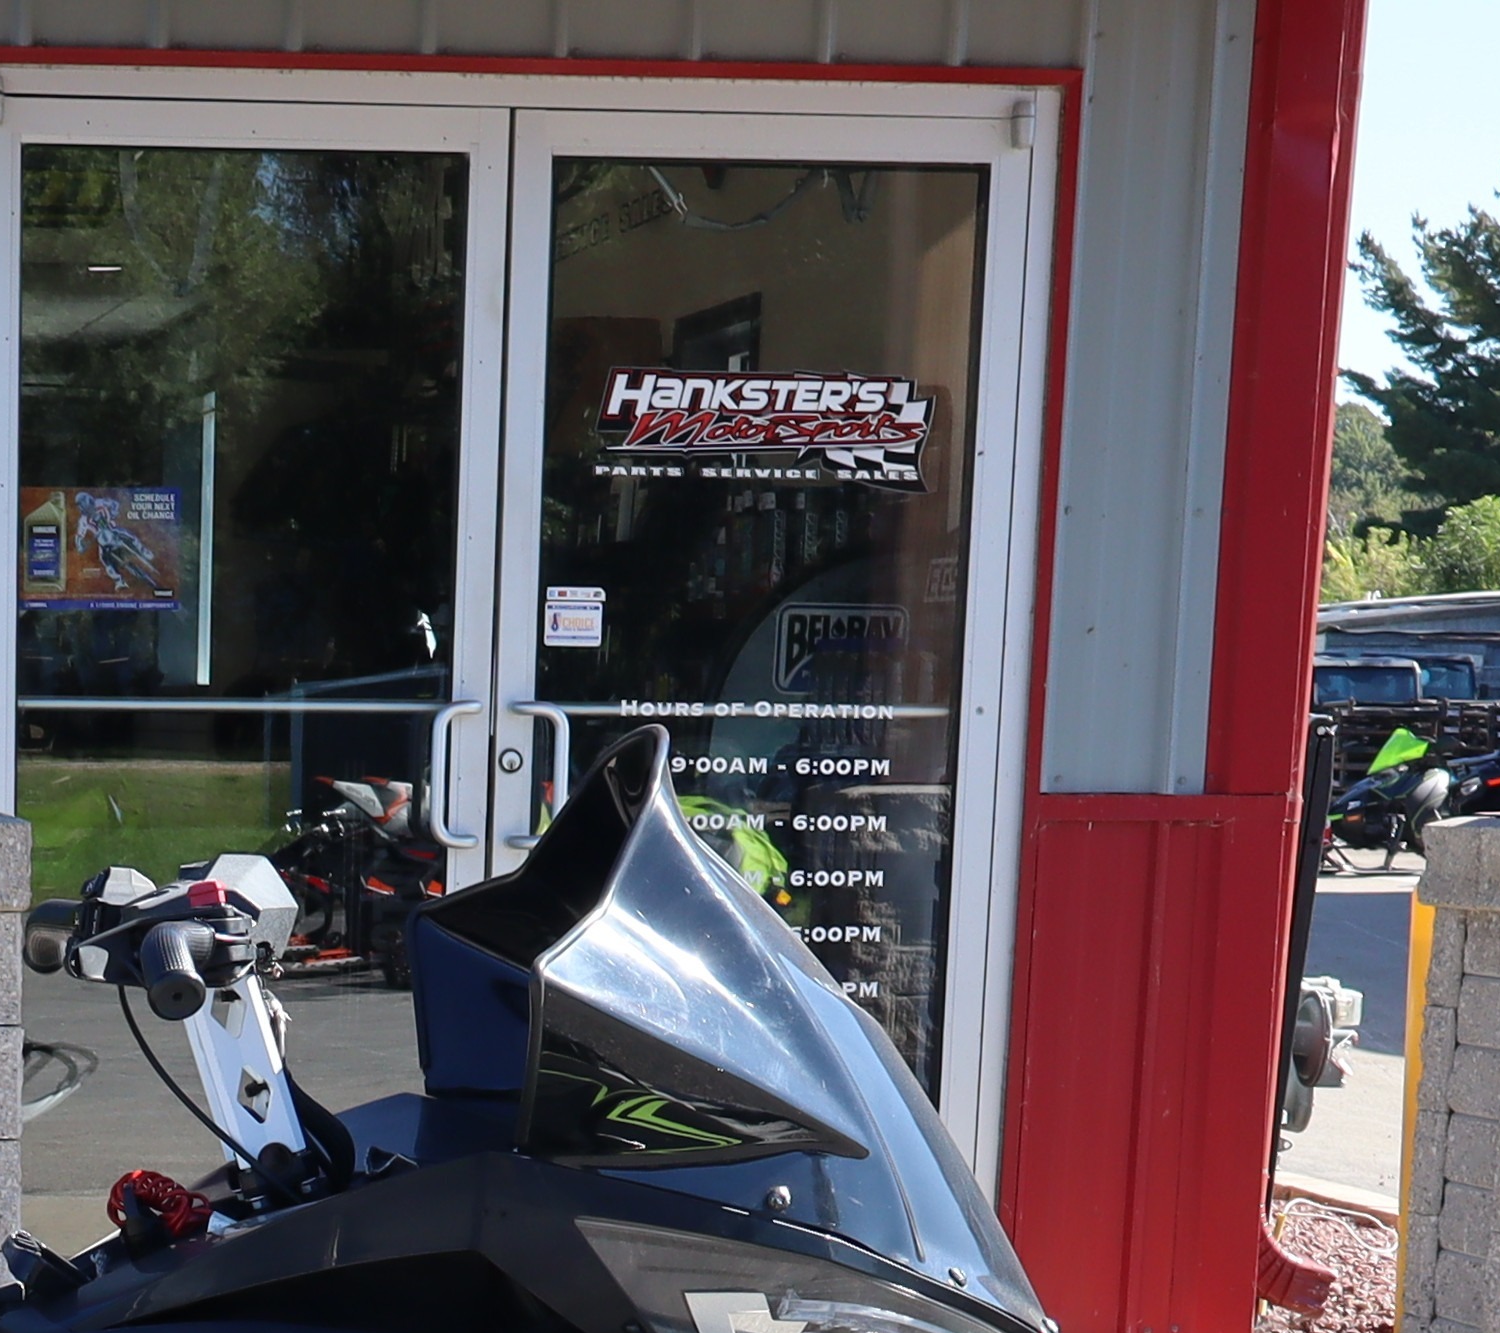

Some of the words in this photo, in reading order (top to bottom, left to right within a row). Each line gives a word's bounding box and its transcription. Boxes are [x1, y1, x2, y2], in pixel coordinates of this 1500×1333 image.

[594, 465, 684, 478] PARTS
[702, 467, 819, 480] SERVICE
[837, 468, 919, 482] SALES
[133, 493, 175, 502] SCHEDULE
[131, 502, 153, 511] YOUR
[154, 502, 175, 511] NEXT
[126, 511, 140, 520] OIL
[142, 511, 175, 520] CHANGE
[795, 758, 890, 776] 6:00PM
[792, 814, 887, 832] 6:00PM
[789, 870, 884, 887] 6:00PM
